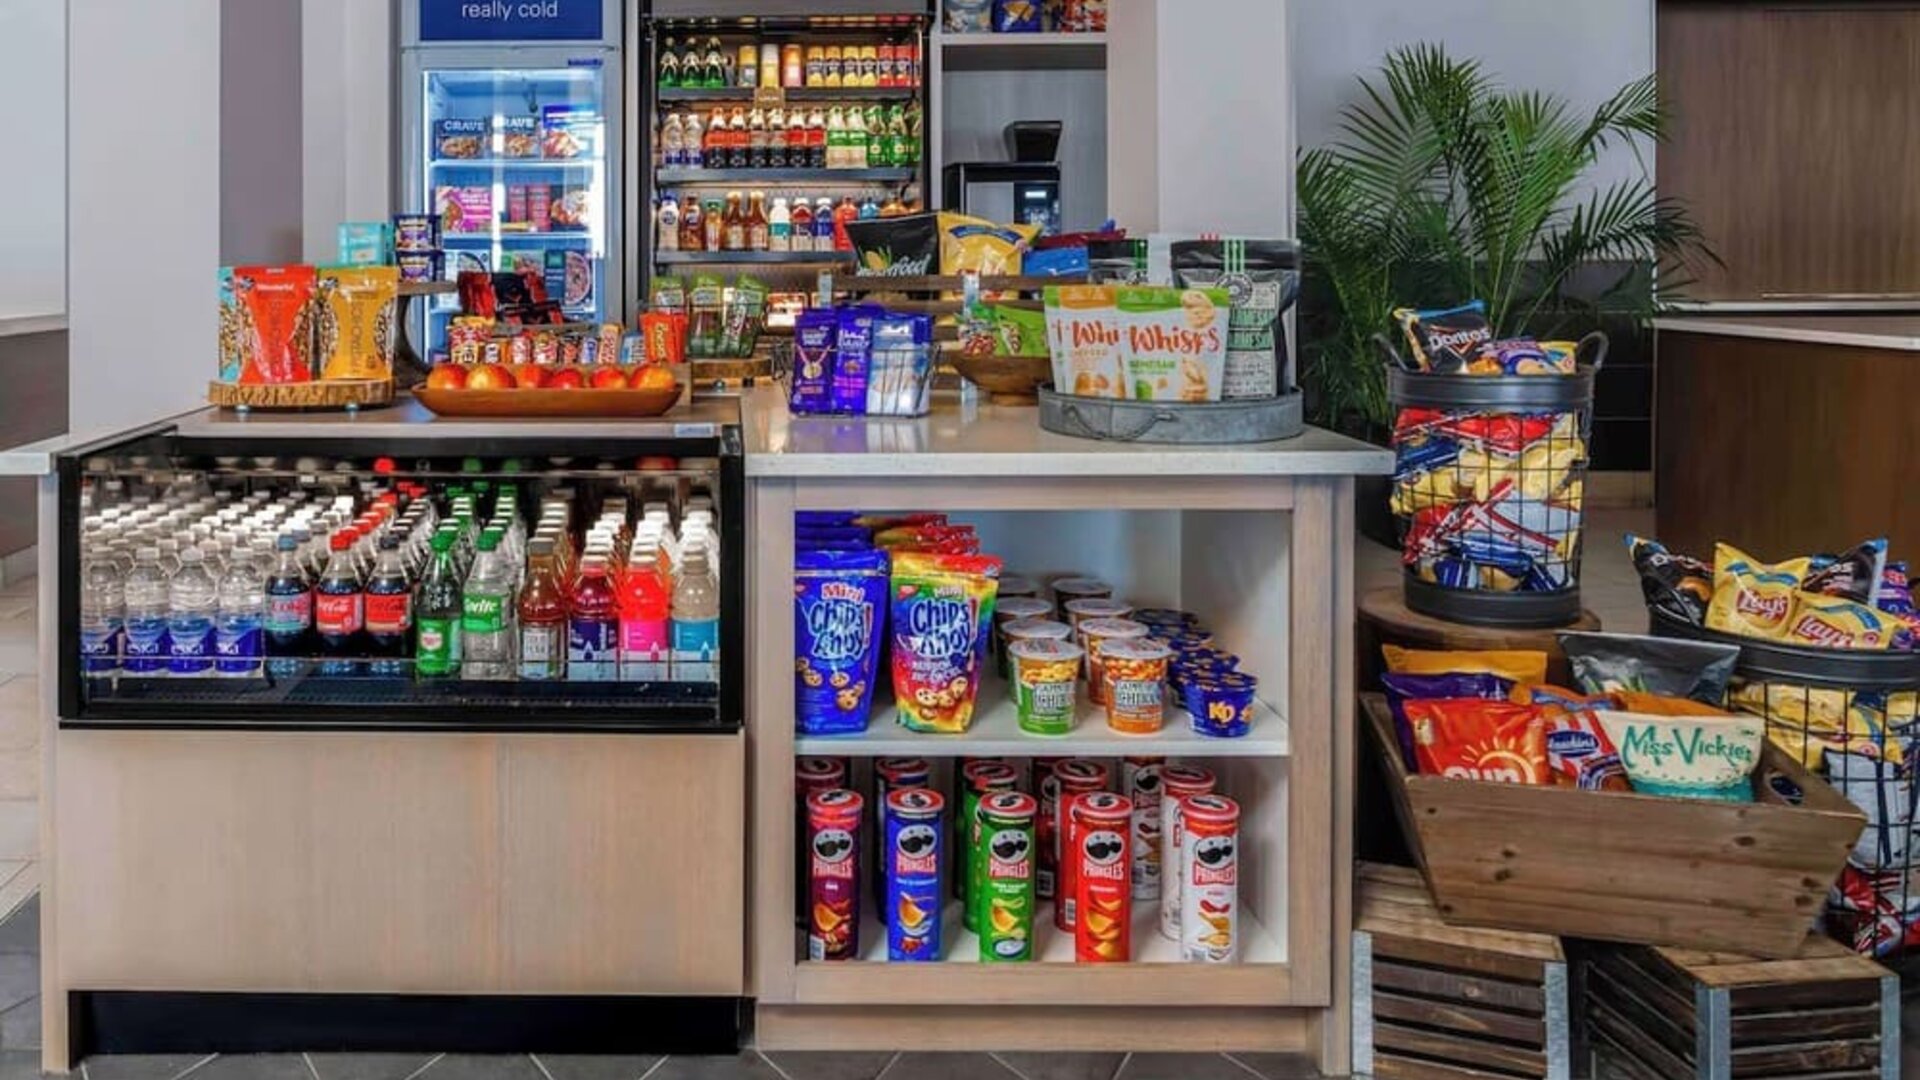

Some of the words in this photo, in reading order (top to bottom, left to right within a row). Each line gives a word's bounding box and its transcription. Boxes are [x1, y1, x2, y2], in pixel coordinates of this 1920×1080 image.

[461, 0, 512, 20] really
[517, 0, 558, 18] cold
[443, 120, 485, 131] CRAVE
[1428, 328, 1491, 352] Doritos
[822, 582, 865, 603] Mini
[911, 598, 969, 634] Chips
[1208, 700, 1236, 724] KD
[1621, 724, 1674, 769] Miss
[1671, 726, 1753, 767] Vickie's
[813, 853, 853, 878] PRINGLES
[896, 848, 937, 874] PRINGLES
[990, 857, 1029, 878] PRINGLES
[1083, 858, 1124, 880] PRINGLES
[1192, 861, 1235, 886] PRINGLES
